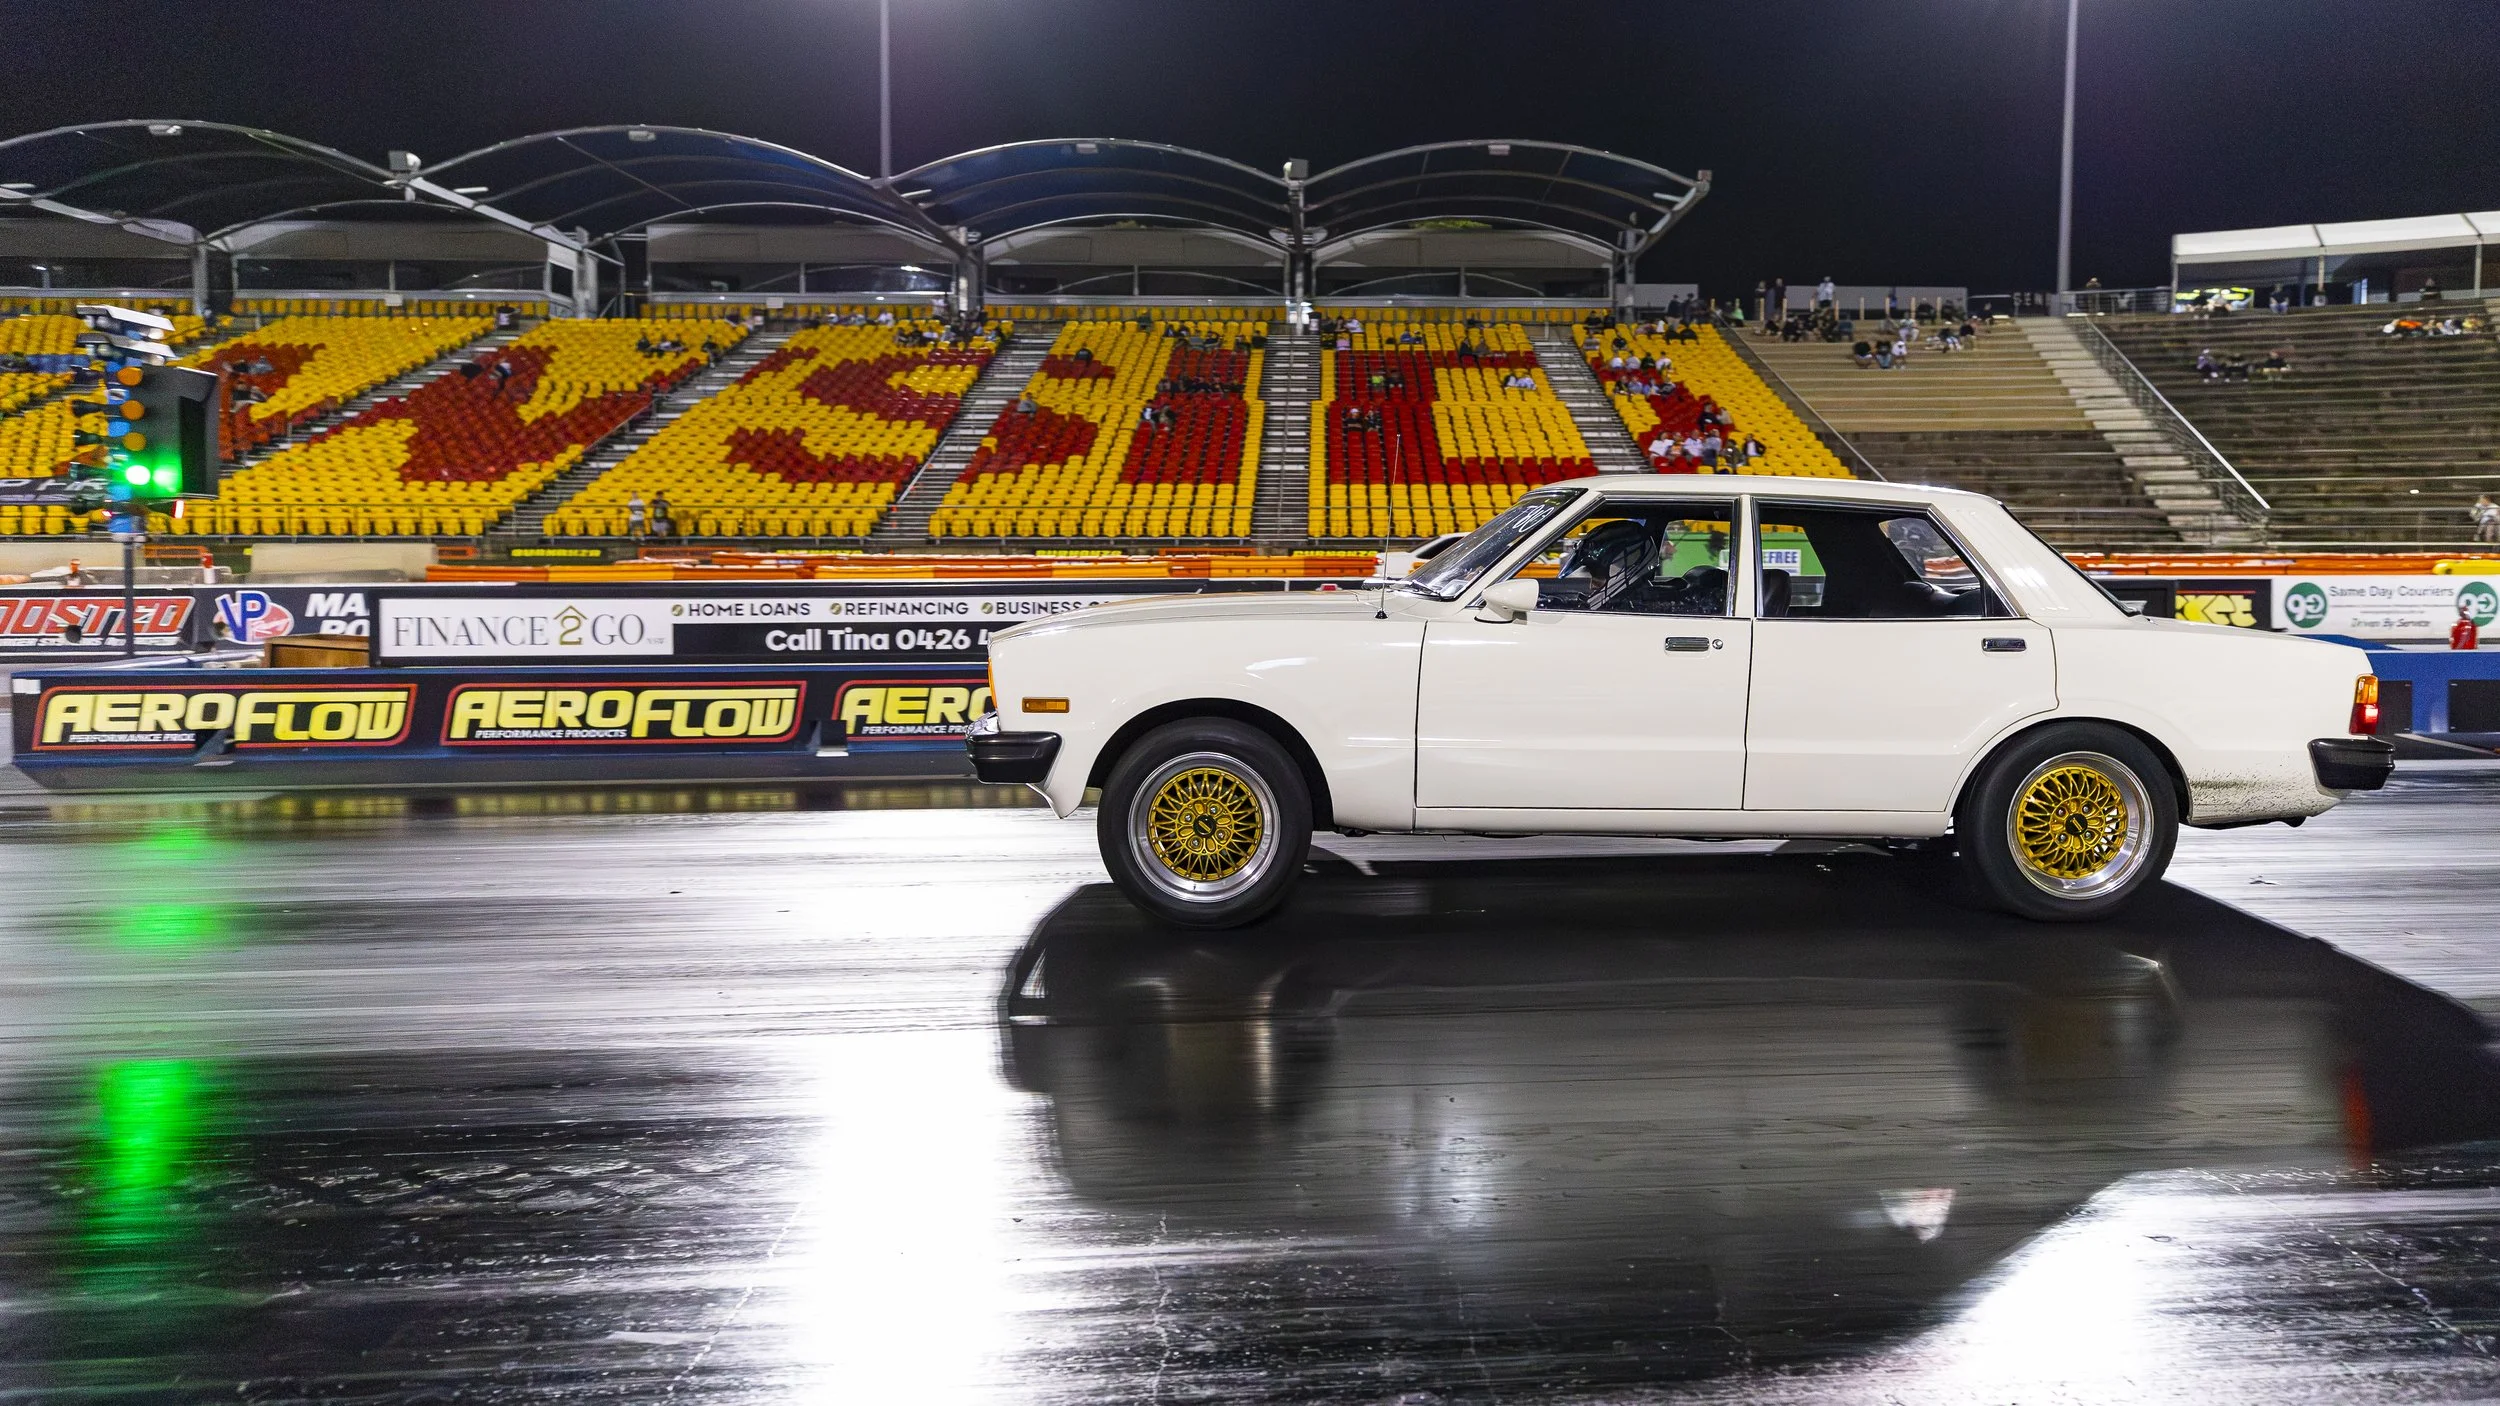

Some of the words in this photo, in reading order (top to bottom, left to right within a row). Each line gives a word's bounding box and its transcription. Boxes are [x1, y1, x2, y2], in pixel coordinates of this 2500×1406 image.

[2329, 586, 2366, 597] Same
[2369, 586, 2393, 599] Day
[2397, 585, 2454, 597] Couriers
[688, 603, 744, 616] HOME
[750, 602, 811, 616] LOANS
[845, 602, 969, 615] REFINANCING
[996, 601, 1082, 615] BUSINESS
[215, 591, 271, 643] VP
[392, 616, 549, 646] FINANCE
[558, 615, 584, 645] 2
[592, 614, 645, 646] GO
[765, 628, 822, 651] Call
[827, 627, 890, 651] Tina
[896, 628, 972, 650] 0426
[41, 690, 408, 743] AEROFLOW
[450, 688, 798, 738] AEROFLOW
[475, 730, 563, 739] PERFORMANCE
[565, 729, 627, 738] PRODUCTS
[862, 725, 946, 734] PERFORMANCE
[69, 733, 161, 743] PERFORMANCE
